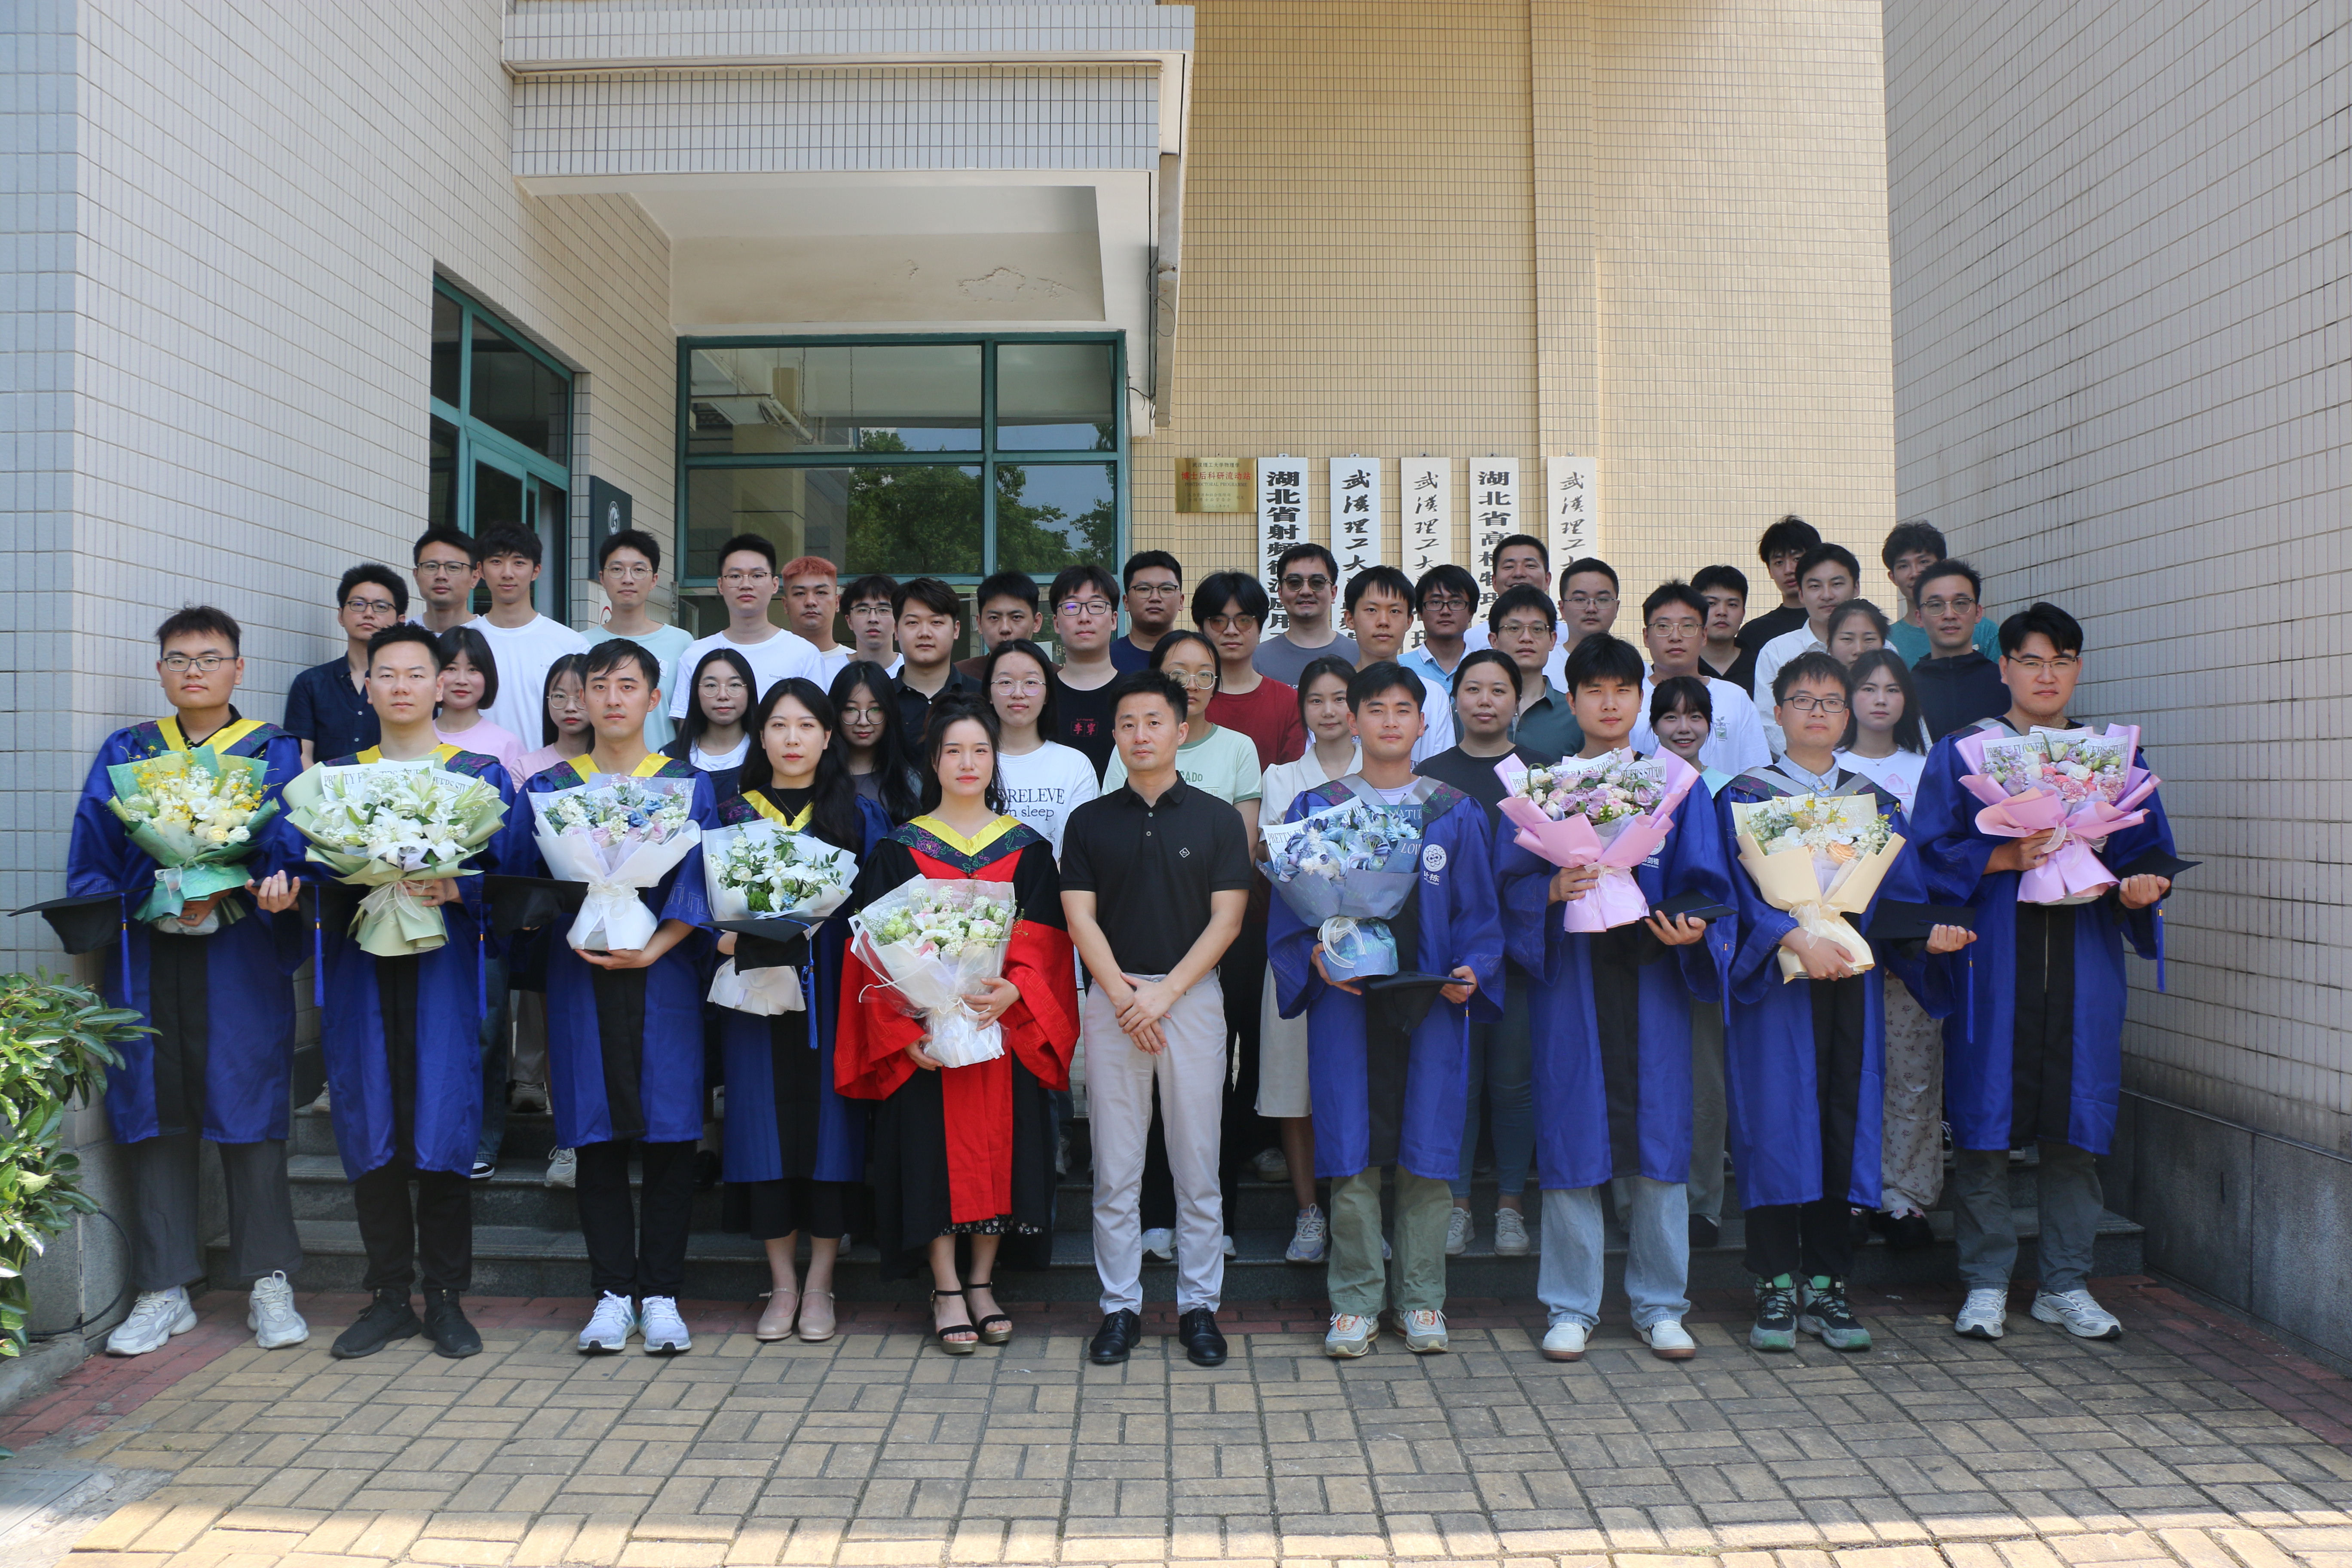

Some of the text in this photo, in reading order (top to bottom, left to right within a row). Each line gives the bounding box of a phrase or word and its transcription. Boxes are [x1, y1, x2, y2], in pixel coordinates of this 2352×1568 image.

[1181, 472, 1251, 480] 博士后科研流动站
[1341, 469, 1371, 575] 武漢理工大
[1413, 471, 1439, 575] 武漢理工大
[324, 773, 355, 786] PRTY
[1001, 788, 1065, 804] RELEVE
[1021, 805, 1054, 821] sleep
